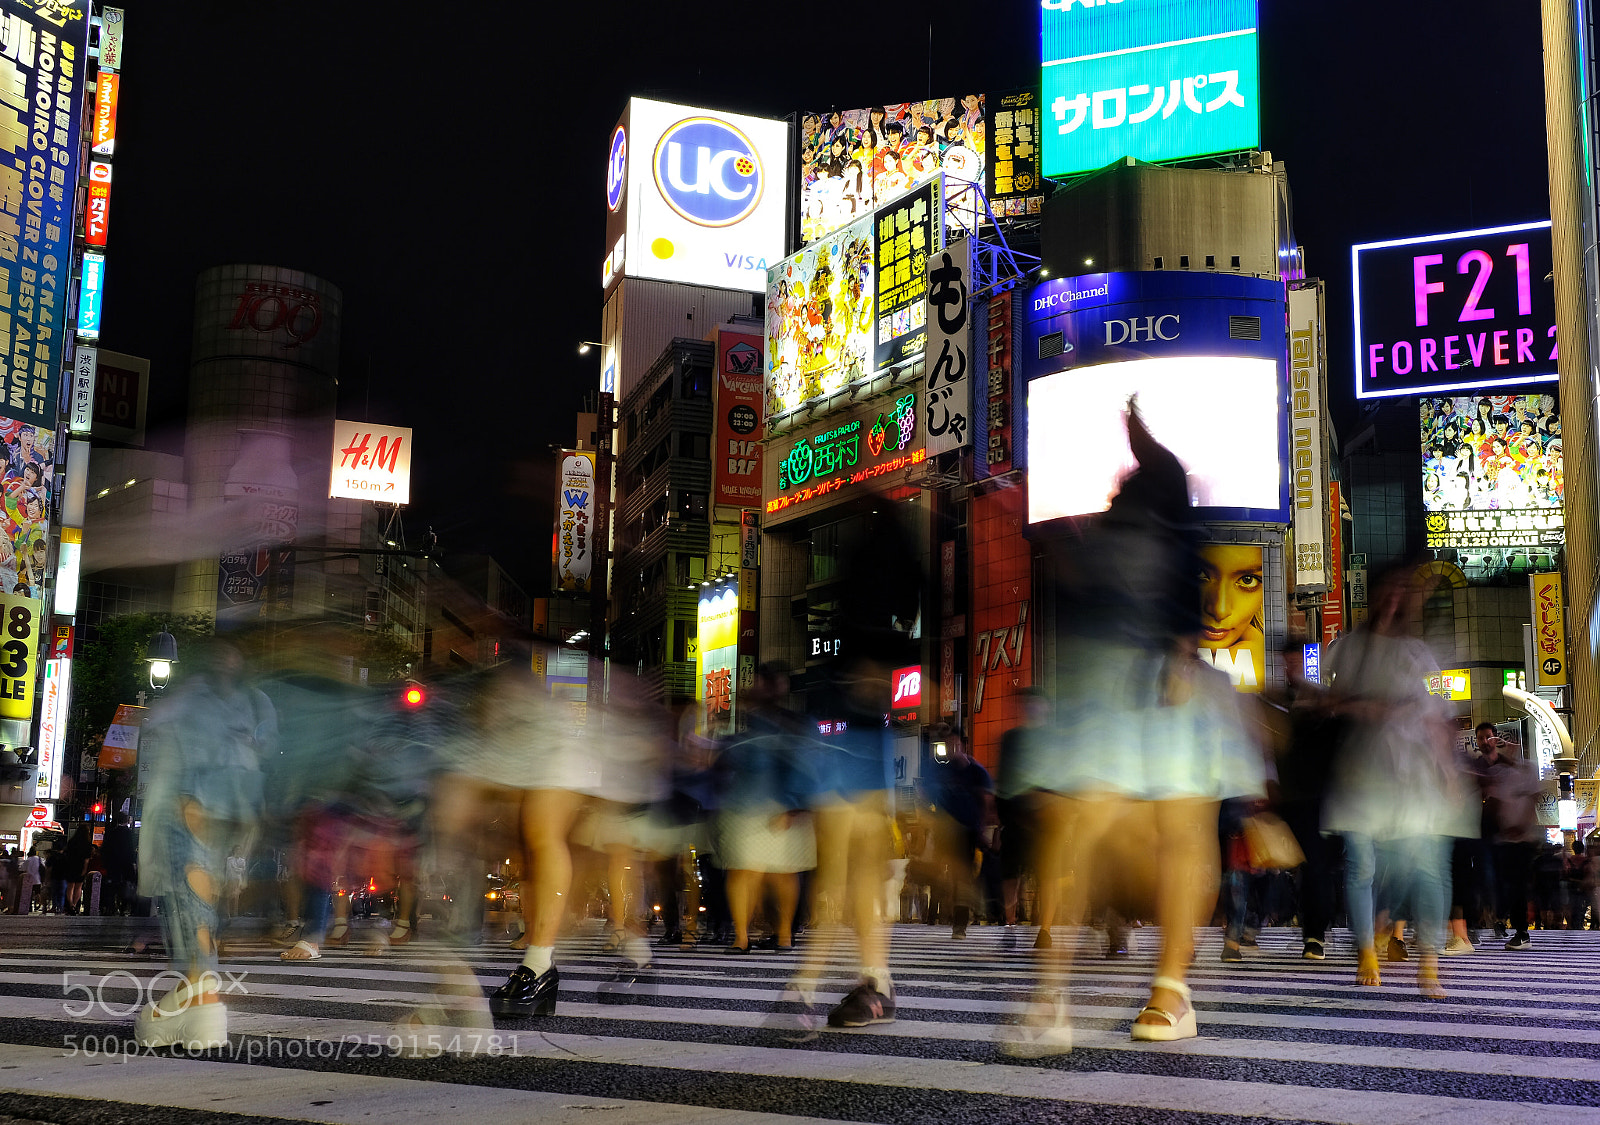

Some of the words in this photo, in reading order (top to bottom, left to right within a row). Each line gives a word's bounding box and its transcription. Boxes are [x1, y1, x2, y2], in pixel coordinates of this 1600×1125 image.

[104, 24, 118, 65] しゃぶ葉
[32, 29, 57, 151] MOMOIRO
[1051, 70, 1245, 135] サロンパス
[667, 141, 753, 200] UC
[25, 155, 46, 243] CLOVER
[91, 198, 106, 236] ガスト
[23, 246, 38, 264] Z
[724, 252, 767, 271] VISA
[18, 266, 37, 324] BEST
[878, 295, 898, 313] BEST
[898, 283, 925, 304] ALBUM
[1034, 293, 1059, 311] DHC
[1059, 283, 1109, 305] Channel
[1413, 242, 1532, 327] F21
[224, 292, 322, 349] 109
[1103, 314, 1180, 346] DHC
[10, 322, 31, 410] ALBUM
[927, 252, 967, 444] もんじゃ
[1292, 319, 1316, 419] Taisei
[1369, 328, 1535, 378] FOREVER
[1547, 325, 1560, 361] 2
[75, 354, 92, 424] 渋谷駅前ビル
[98, 371, 128, 397] NI
[987, 299, 1005, 465] 三千里薬品
[733, 412, 754, 420] 10:00
[340, 432, 403, 475] H&M
[728, 458, 757, 476] B2F
[729, 439, 756, 457] B1F
[813, 434, 860, 477] 西村
[1294, 427, 1314, 510] neon
[345, 479, 381, 492] 150m
[1298, 553, 1322, 563] 3719
[1427, 538, 1488, 548] 2018.5.23
[1489, 537, 1509, 547] ON
[1509, 536, 1539, 546] SALE
[228, 575, 254, 586] ガラクト
[975, 600, 1029, 713] クスリ
[1543, 660, 1560, 672] 4F
[706, 668, 731, 714] 薬
[894, 672, 921, 702] JTB
